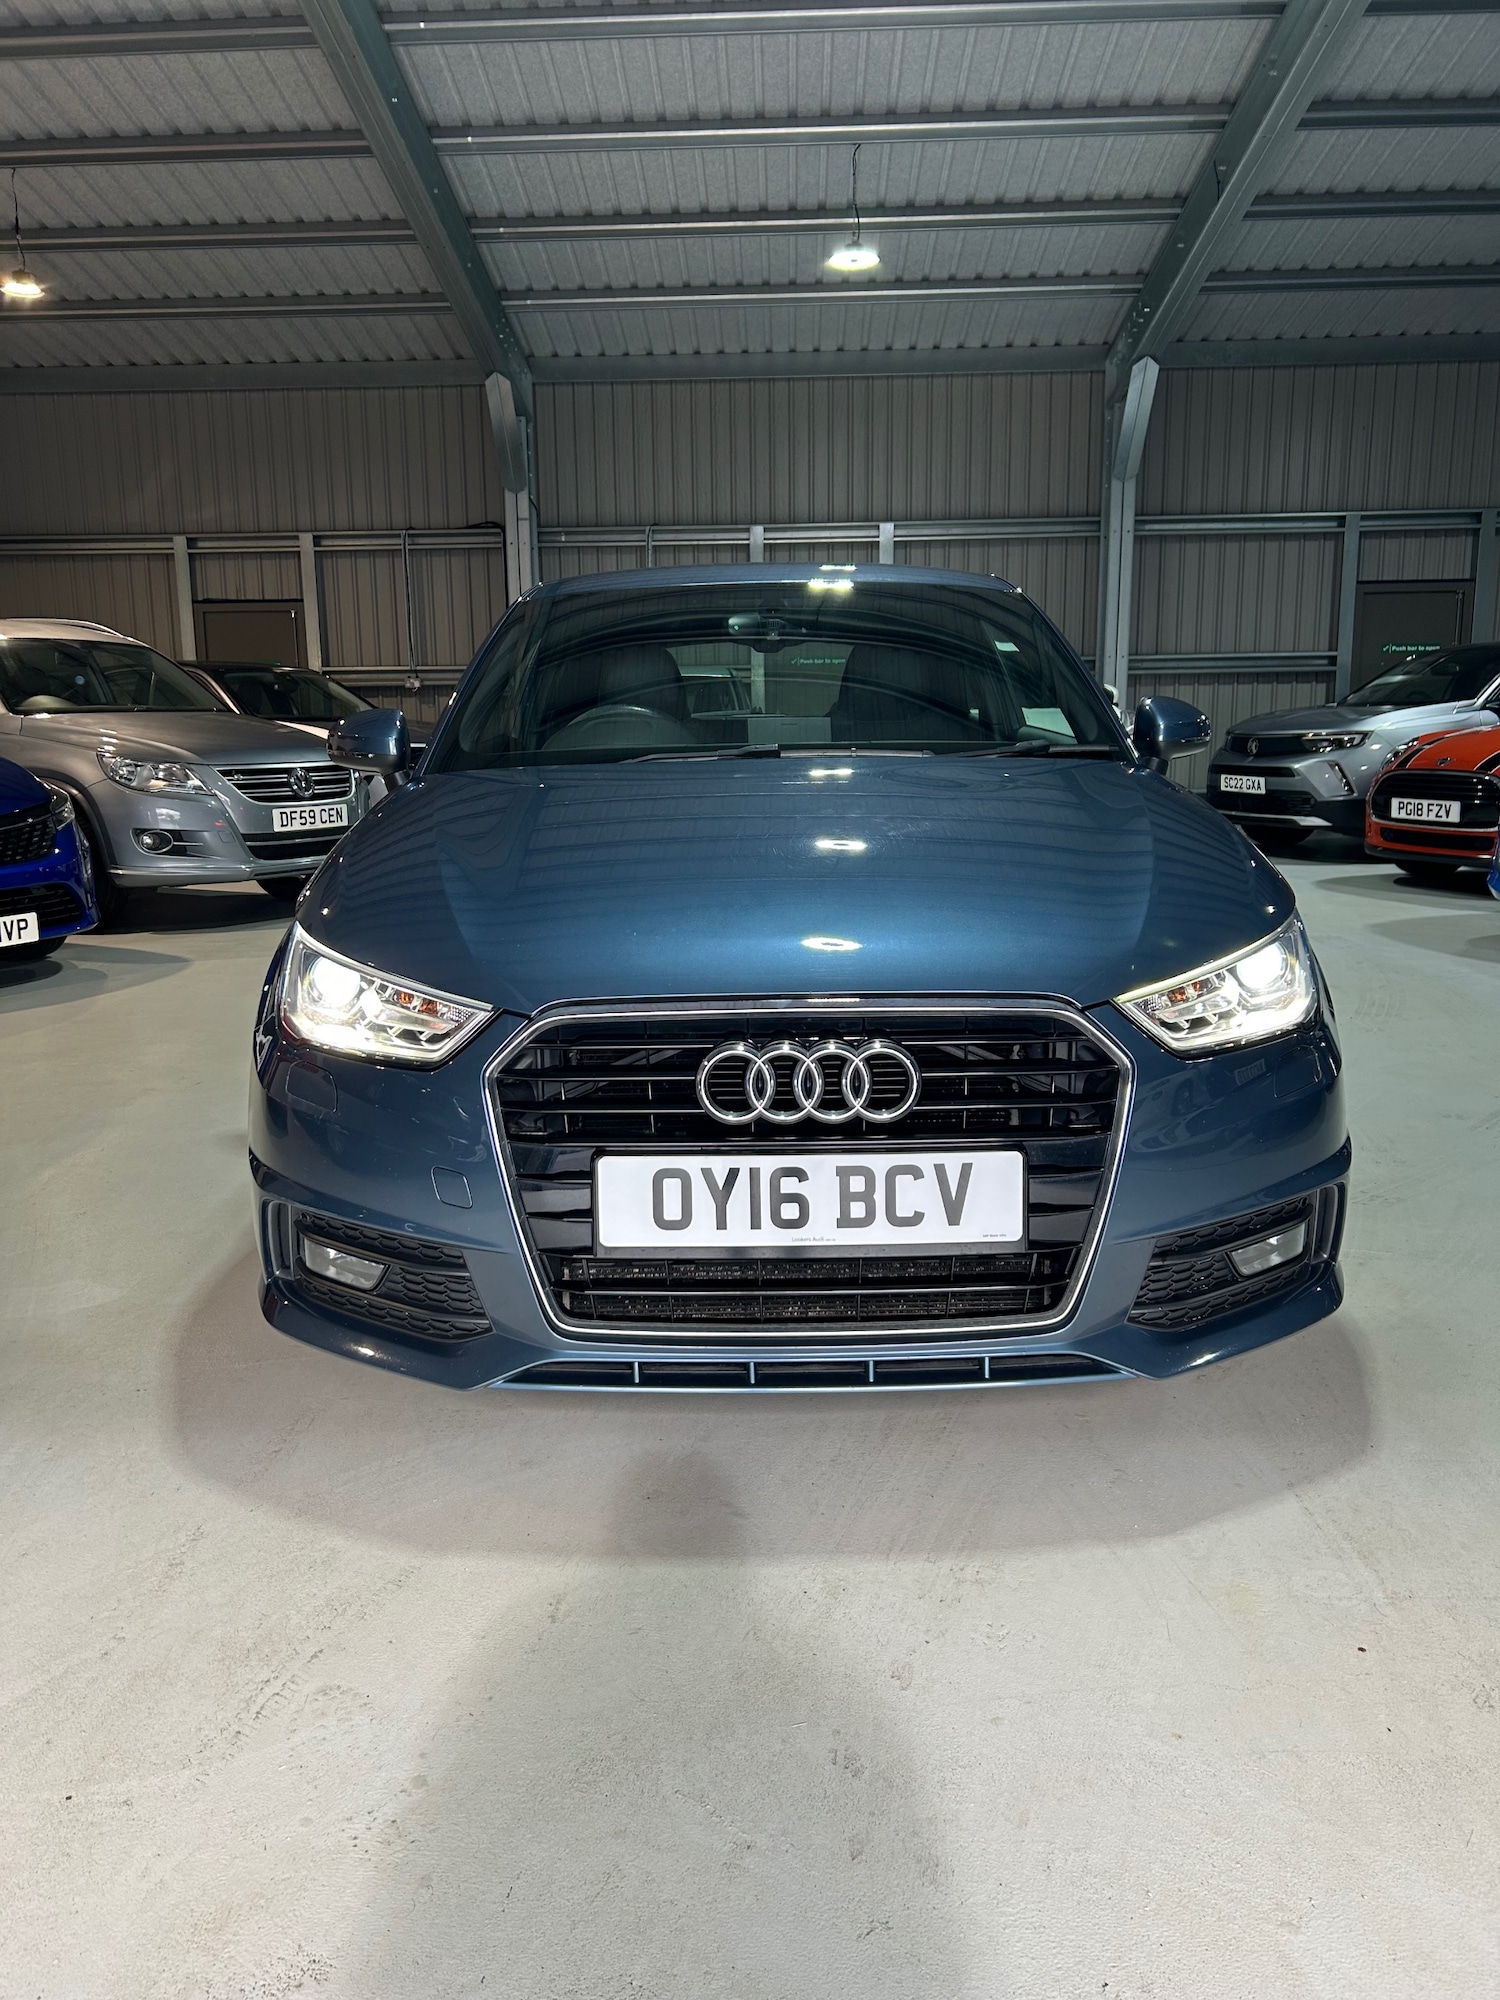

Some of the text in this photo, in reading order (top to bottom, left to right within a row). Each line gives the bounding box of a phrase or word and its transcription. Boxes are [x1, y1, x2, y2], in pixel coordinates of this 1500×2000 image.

[1223, 776, 1262, 791] SC22 GXA
[280, 807, 344, 827] DF59 CEN
[1398, 801, 1452, 819] PG18 FZV
[0, 918, 28, 942] VP
[652, 1162, 973, 1231] OY16 BCV
